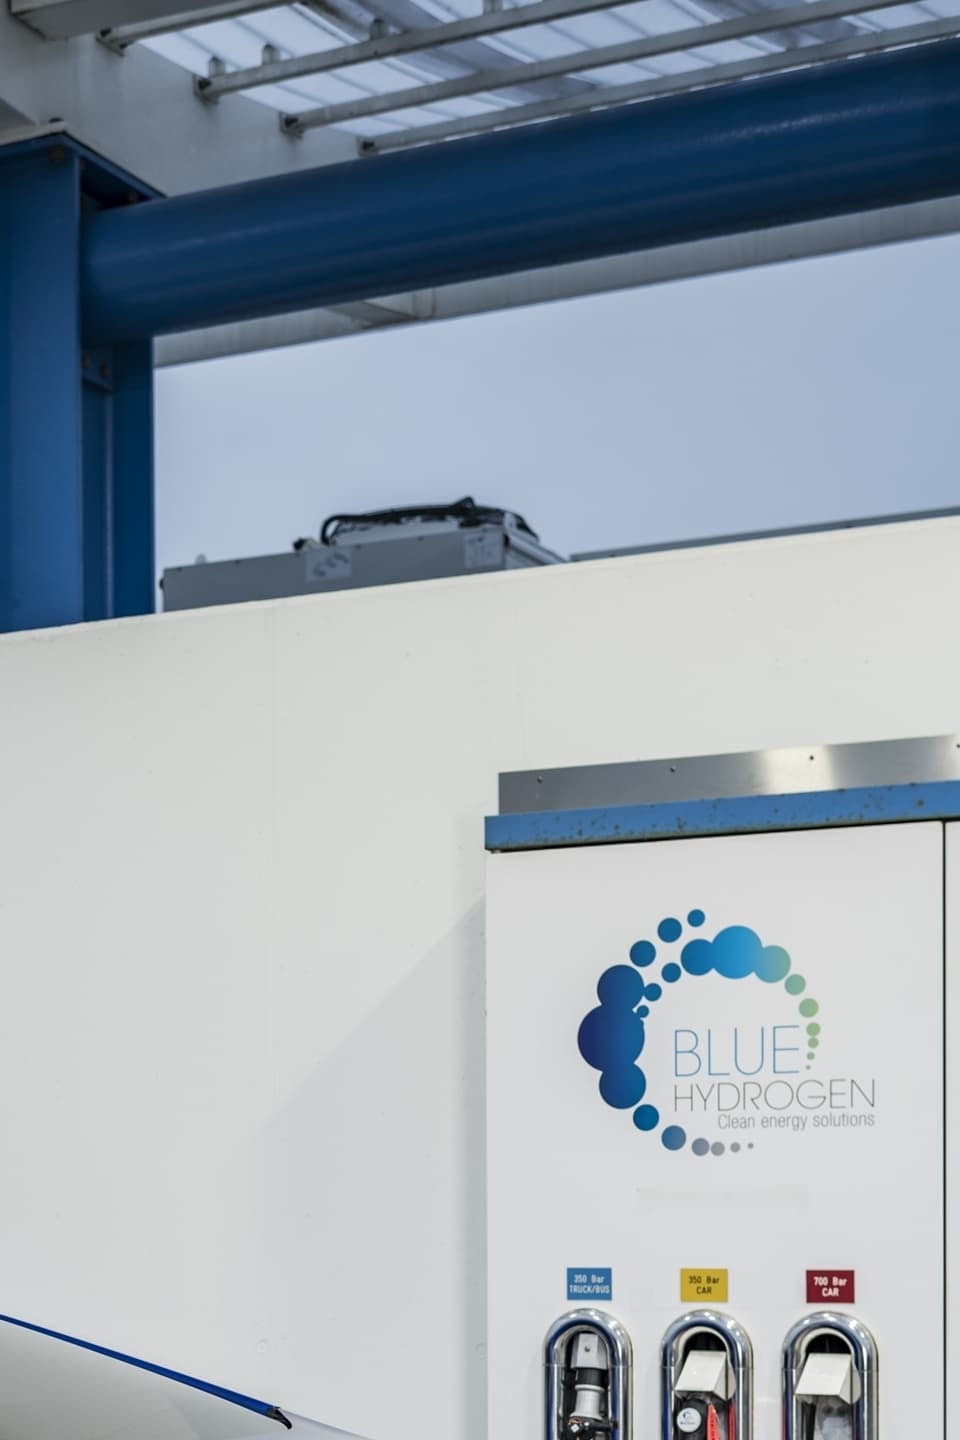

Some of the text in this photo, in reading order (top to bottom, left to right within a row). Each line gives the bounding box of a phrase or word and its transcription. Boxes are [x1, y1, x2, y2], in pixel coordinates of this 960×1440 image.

[674, 1025, 800, 1077] BLUE
[674, 1078, 875, 1113] HYDROGEN
[718, 1112, 875, 1131] Clean energy solutions
[573, 1274, 605, 1284] 350 Bar
[688, 1275, 720, 1285] 350 Bar
[813, 1276, 848, 1286] 700 Bar
[569, 1284, 610, 1294] TRUCK/BUS
[696, 1286, 712, 1295] CAR
[821, 1287, 839, 1297] CAR
